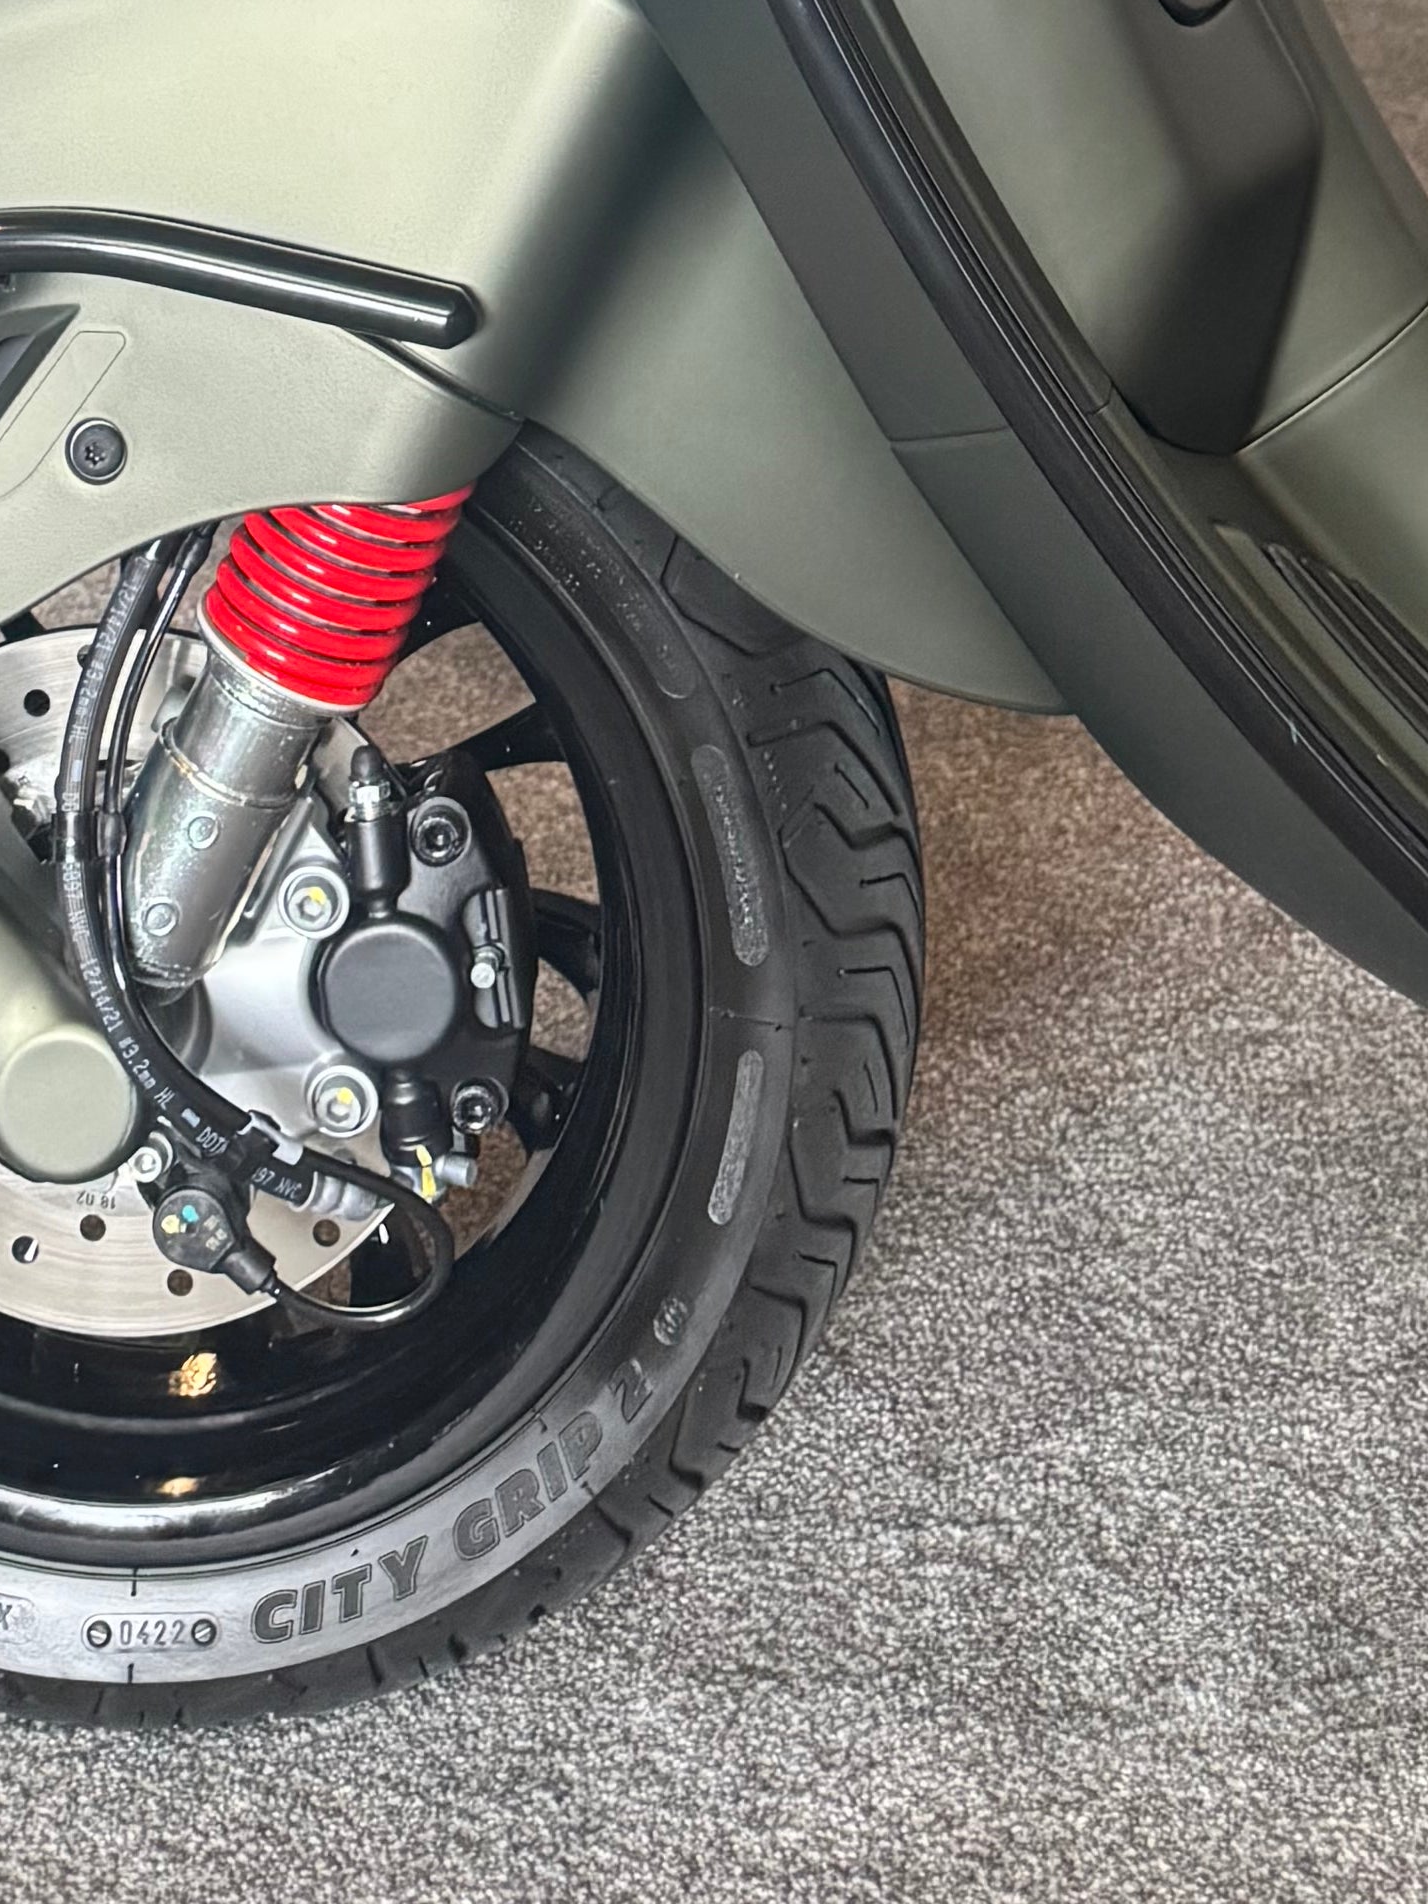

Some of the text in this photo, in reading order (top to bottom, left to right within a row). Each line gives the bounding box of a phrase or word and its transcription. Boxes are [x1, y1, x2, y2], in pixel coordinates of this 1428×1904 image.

[80, 957, 125, 1033] 12/14/21
[250, 1535, 430, 1645] CITY
[451, 1407, 606, 1563] GRIP
[116, 1614, 188, 1650] 0422
